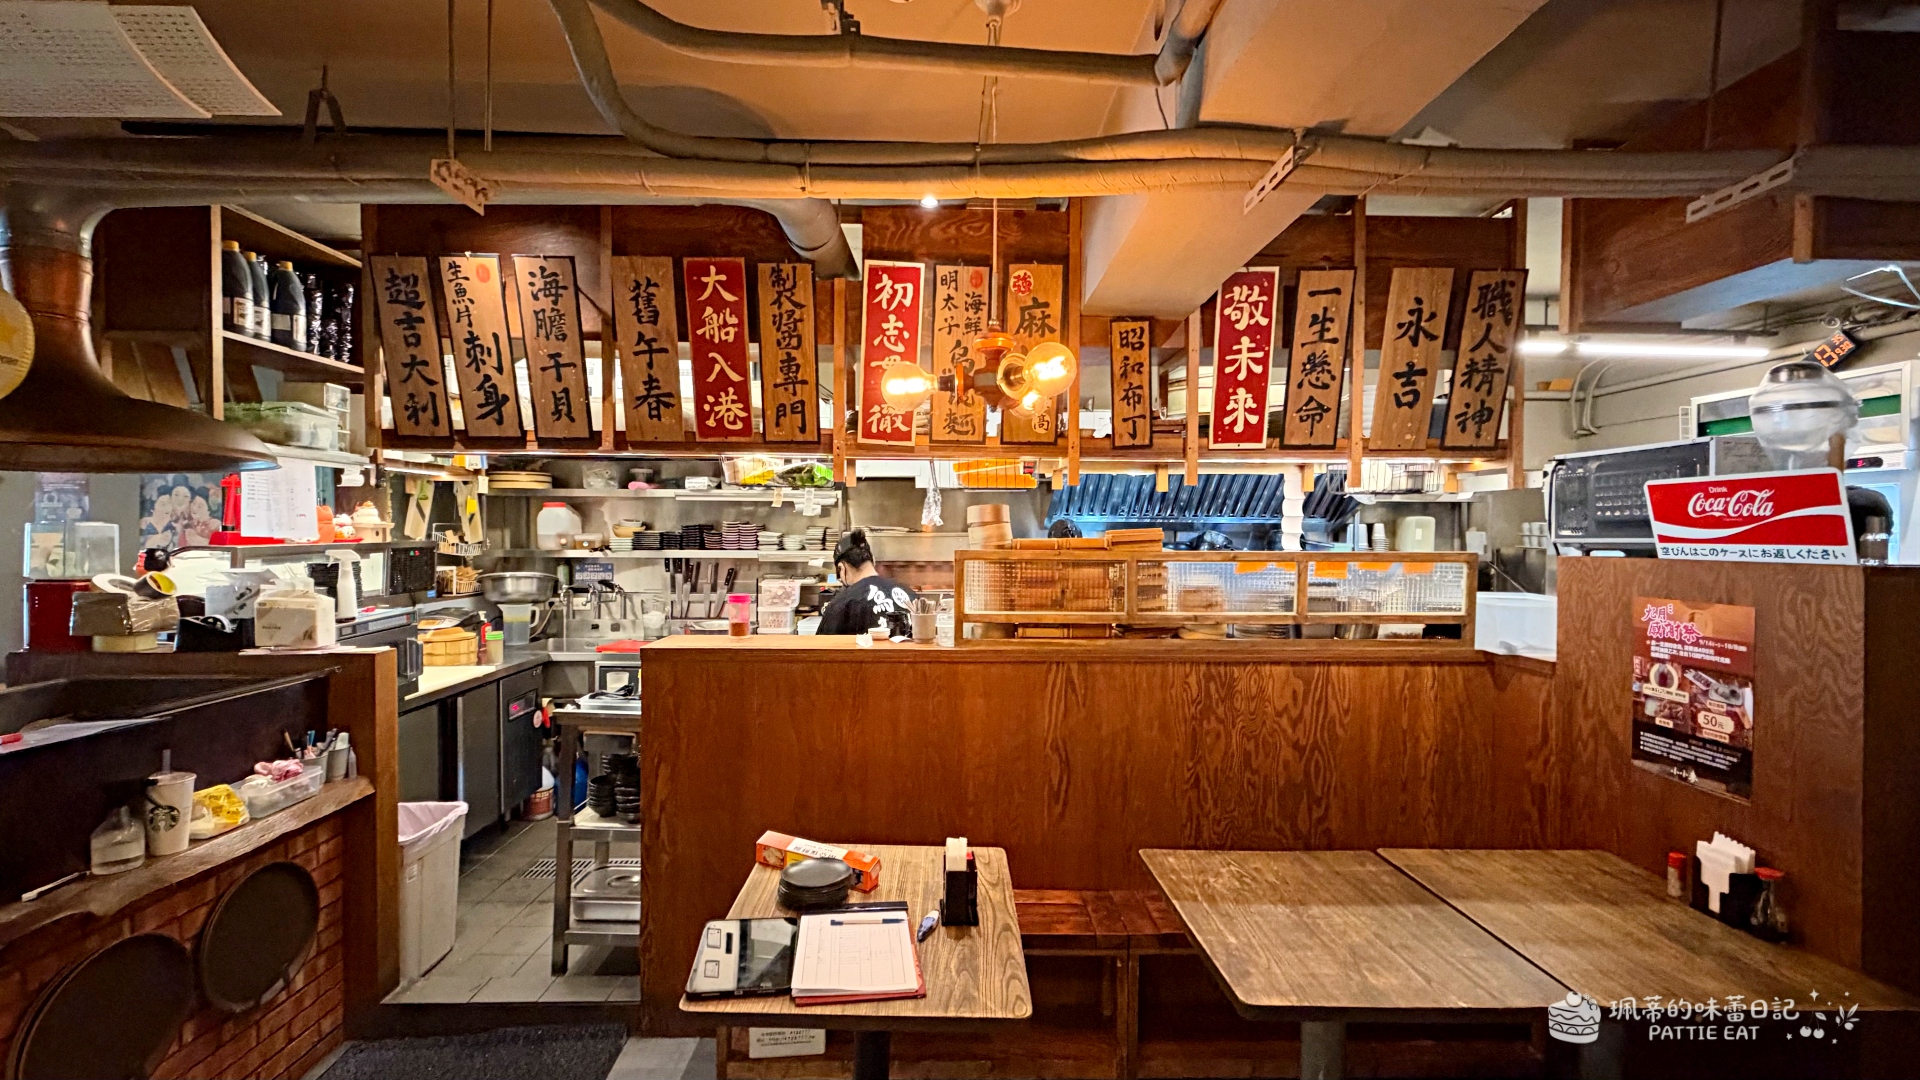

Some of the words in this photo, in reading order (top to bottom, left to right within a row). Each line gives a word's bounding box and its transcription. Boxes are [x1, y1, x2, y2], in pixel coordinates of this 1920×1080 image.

[385, 267, 440, 427] 超吉大利
[446, 261, 475, 328] 生魚片
[528, 265, 577, 424] 海膽干貝
[696, 265, 749, 430] 大船入港
[769, 264, 809, 435] 製醬專門
[938, 270, 961, 336] 明太子
[962, 291, 986, 336] 海鮮
[463, 331, 511, 426] 刺身
[1119, 326, 1146, 441] 昭和布丁
[1223, 284, 1269, 434] 敬未來
[1295, 287, 1342, 438] 一生懸命
[1394, 296, 1440, 410] 永吉
[1455, 279, 1516, 438] 職人精神
[1688, 488, 1775, 518] Coca-Cola
[1708, 486, 1728, 494] Drink
[1660, 546, 1846, 561] 空びんはこのケースにお返しください
[1702, 714, 1725, 730] 50元
